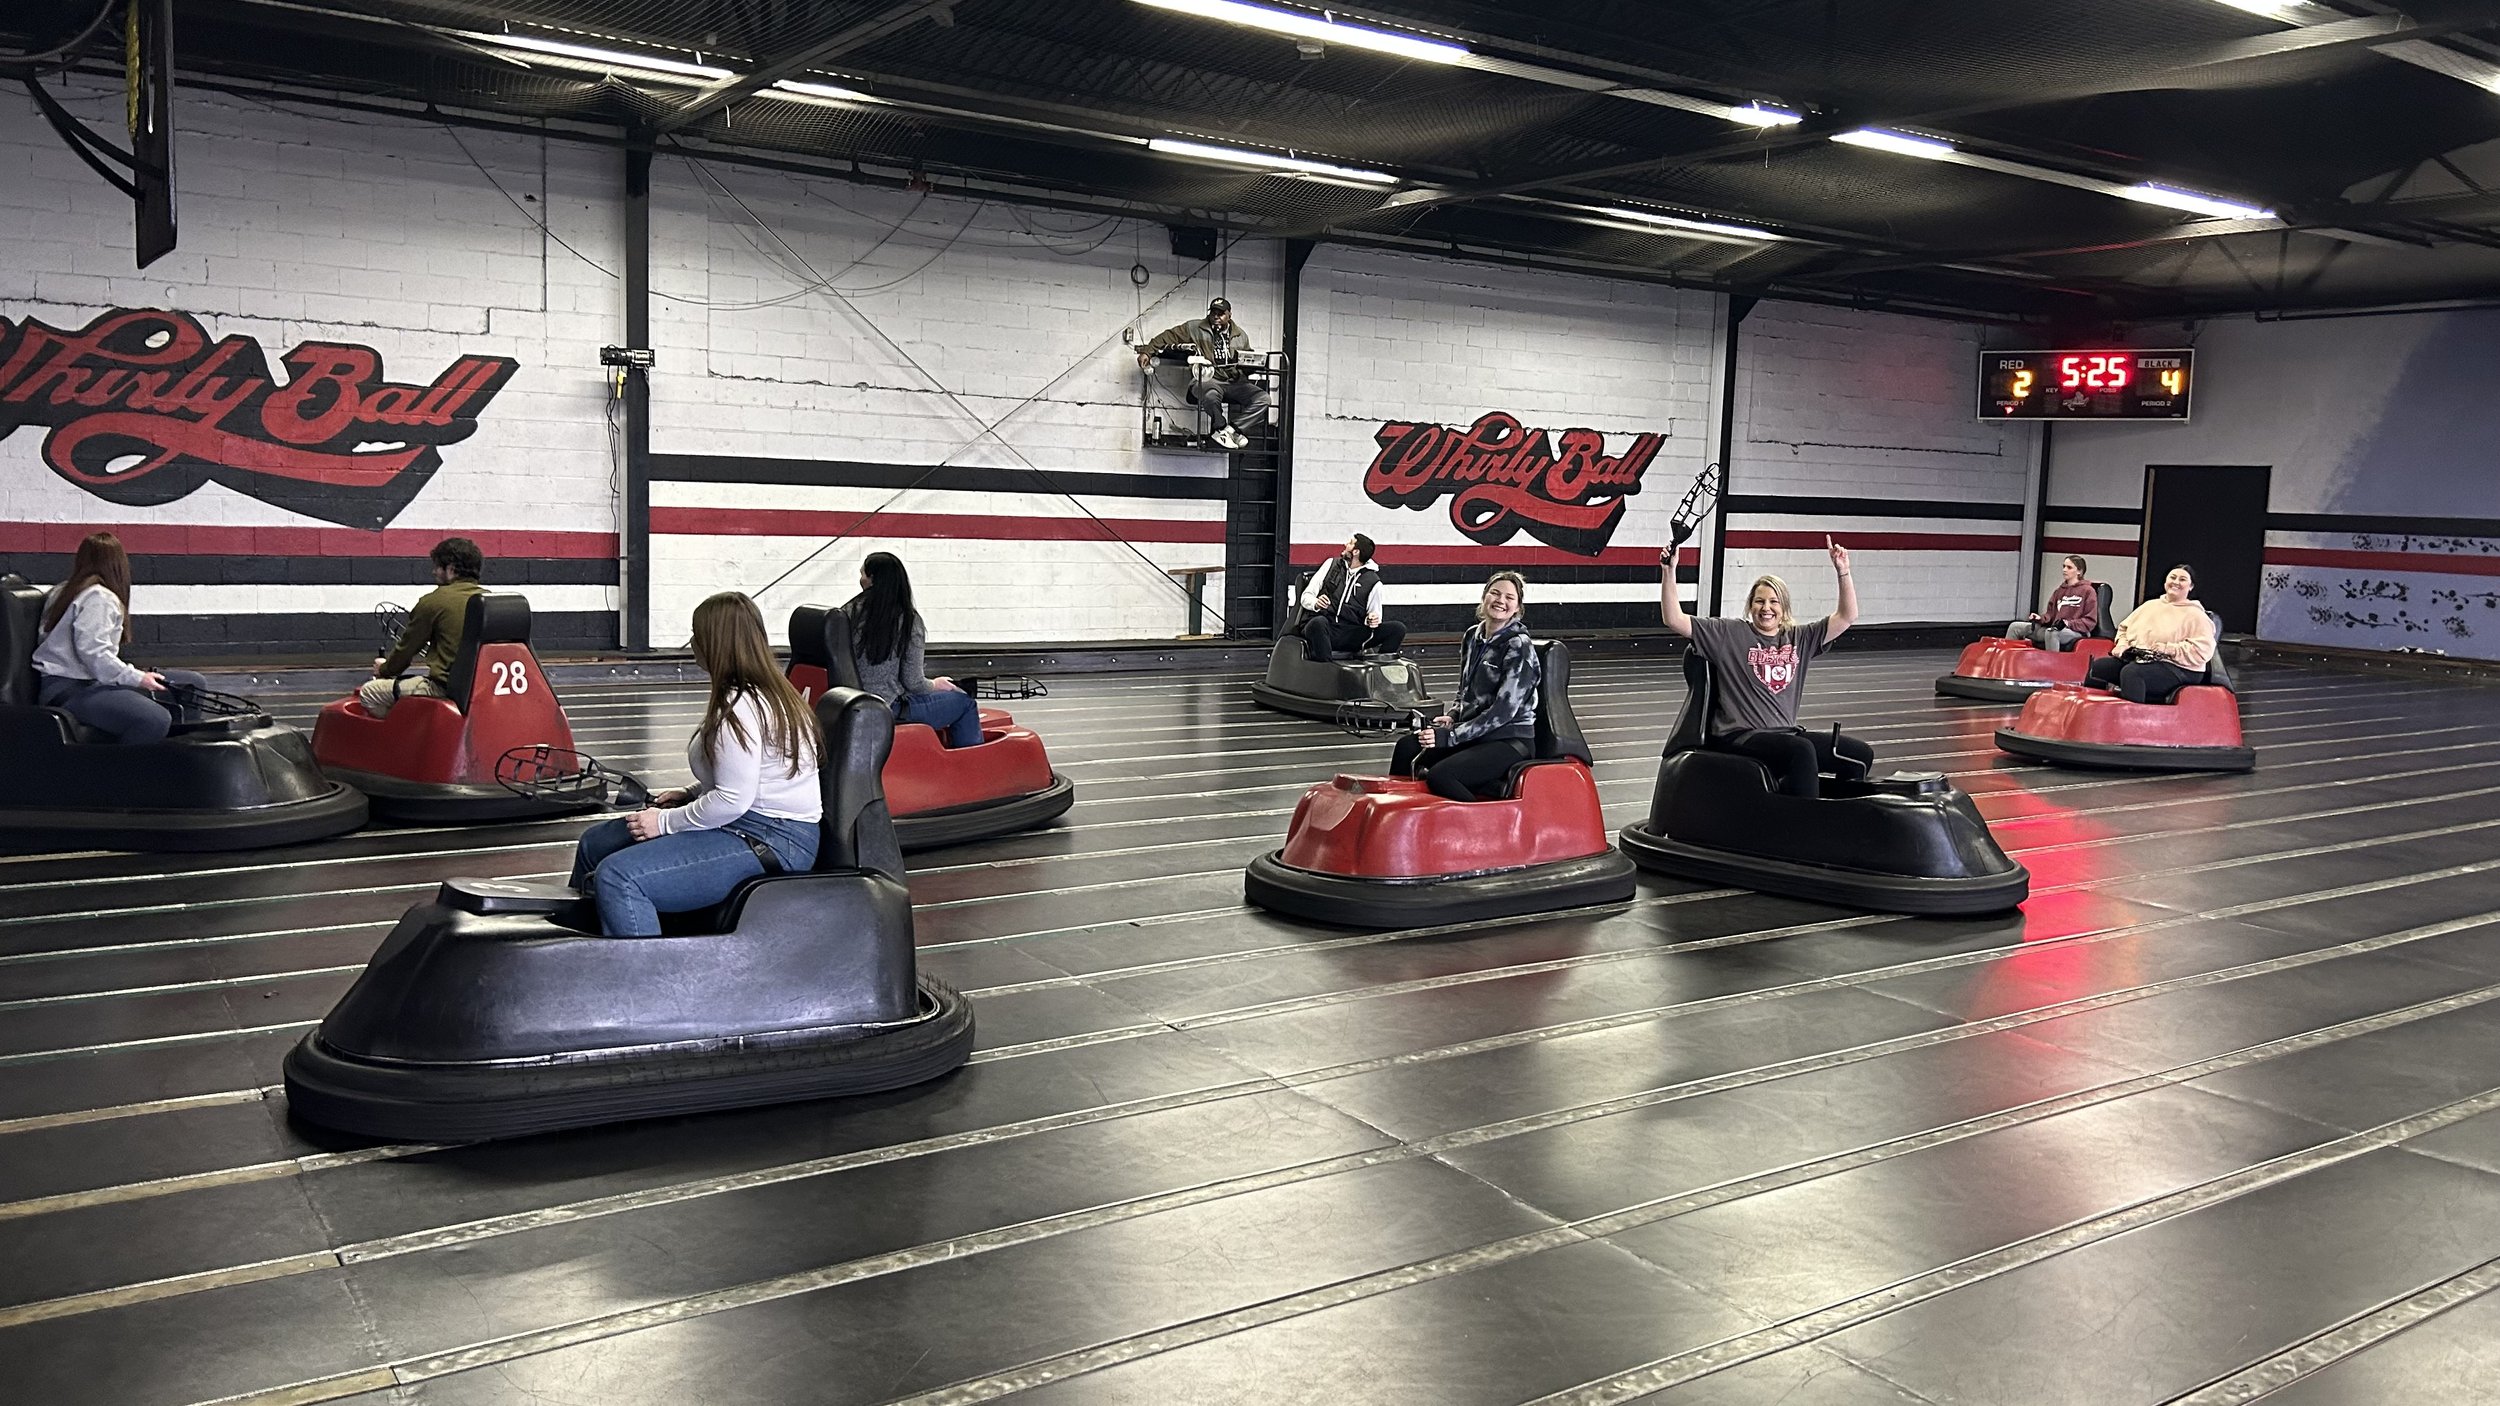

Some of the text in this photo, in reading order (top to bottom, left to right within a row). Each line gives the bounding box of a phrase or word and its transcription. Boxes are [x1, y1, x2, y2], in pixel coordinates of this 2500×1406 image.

[1999, 360, 2024, 370] RED
[2061, 356, 2127, 387] 5:25
[2144, 360, 2173, 368] BLACK
[261, 345, 504, 444] Ball
[2013, 370, 2033, 398] 2
[2161, 369, 2180, 396] 4
[1365, 412, 1661, 531] Whirly Ball
[491, 660, 529, 696] 28
